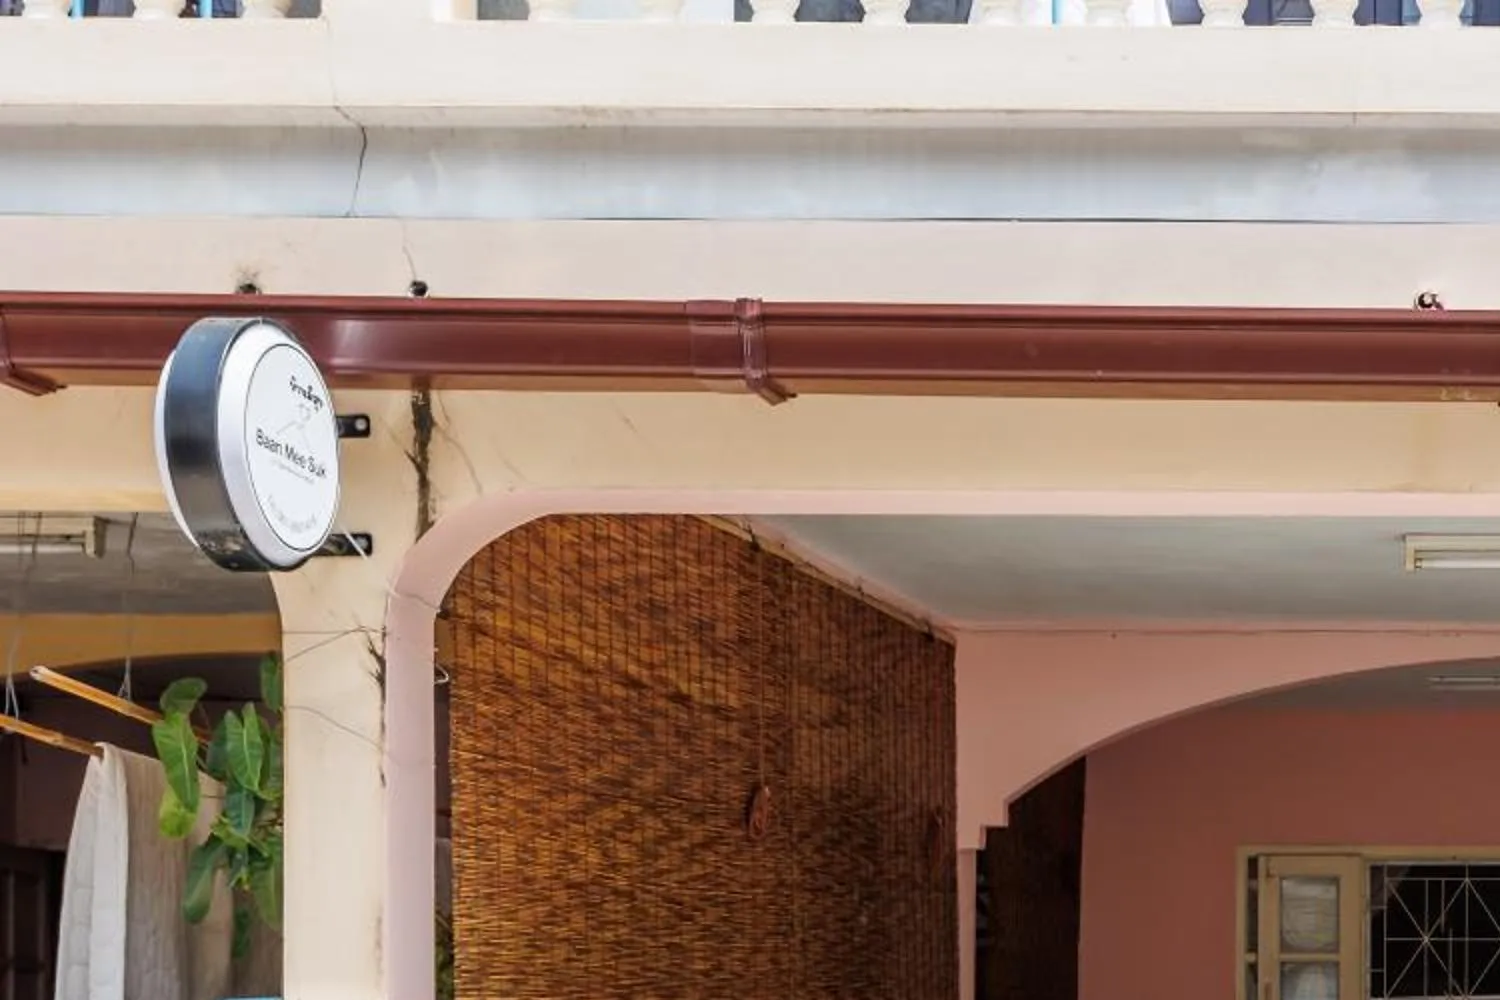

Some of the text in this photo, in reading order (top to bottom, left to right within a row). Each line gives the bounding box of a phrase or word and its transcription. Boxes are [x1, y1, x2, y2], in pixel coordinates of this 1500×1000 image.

[256, 428, 282, 456] Baan
[285, 444, 306, 469] Mee
[308, 456, 327, 478] Suk
